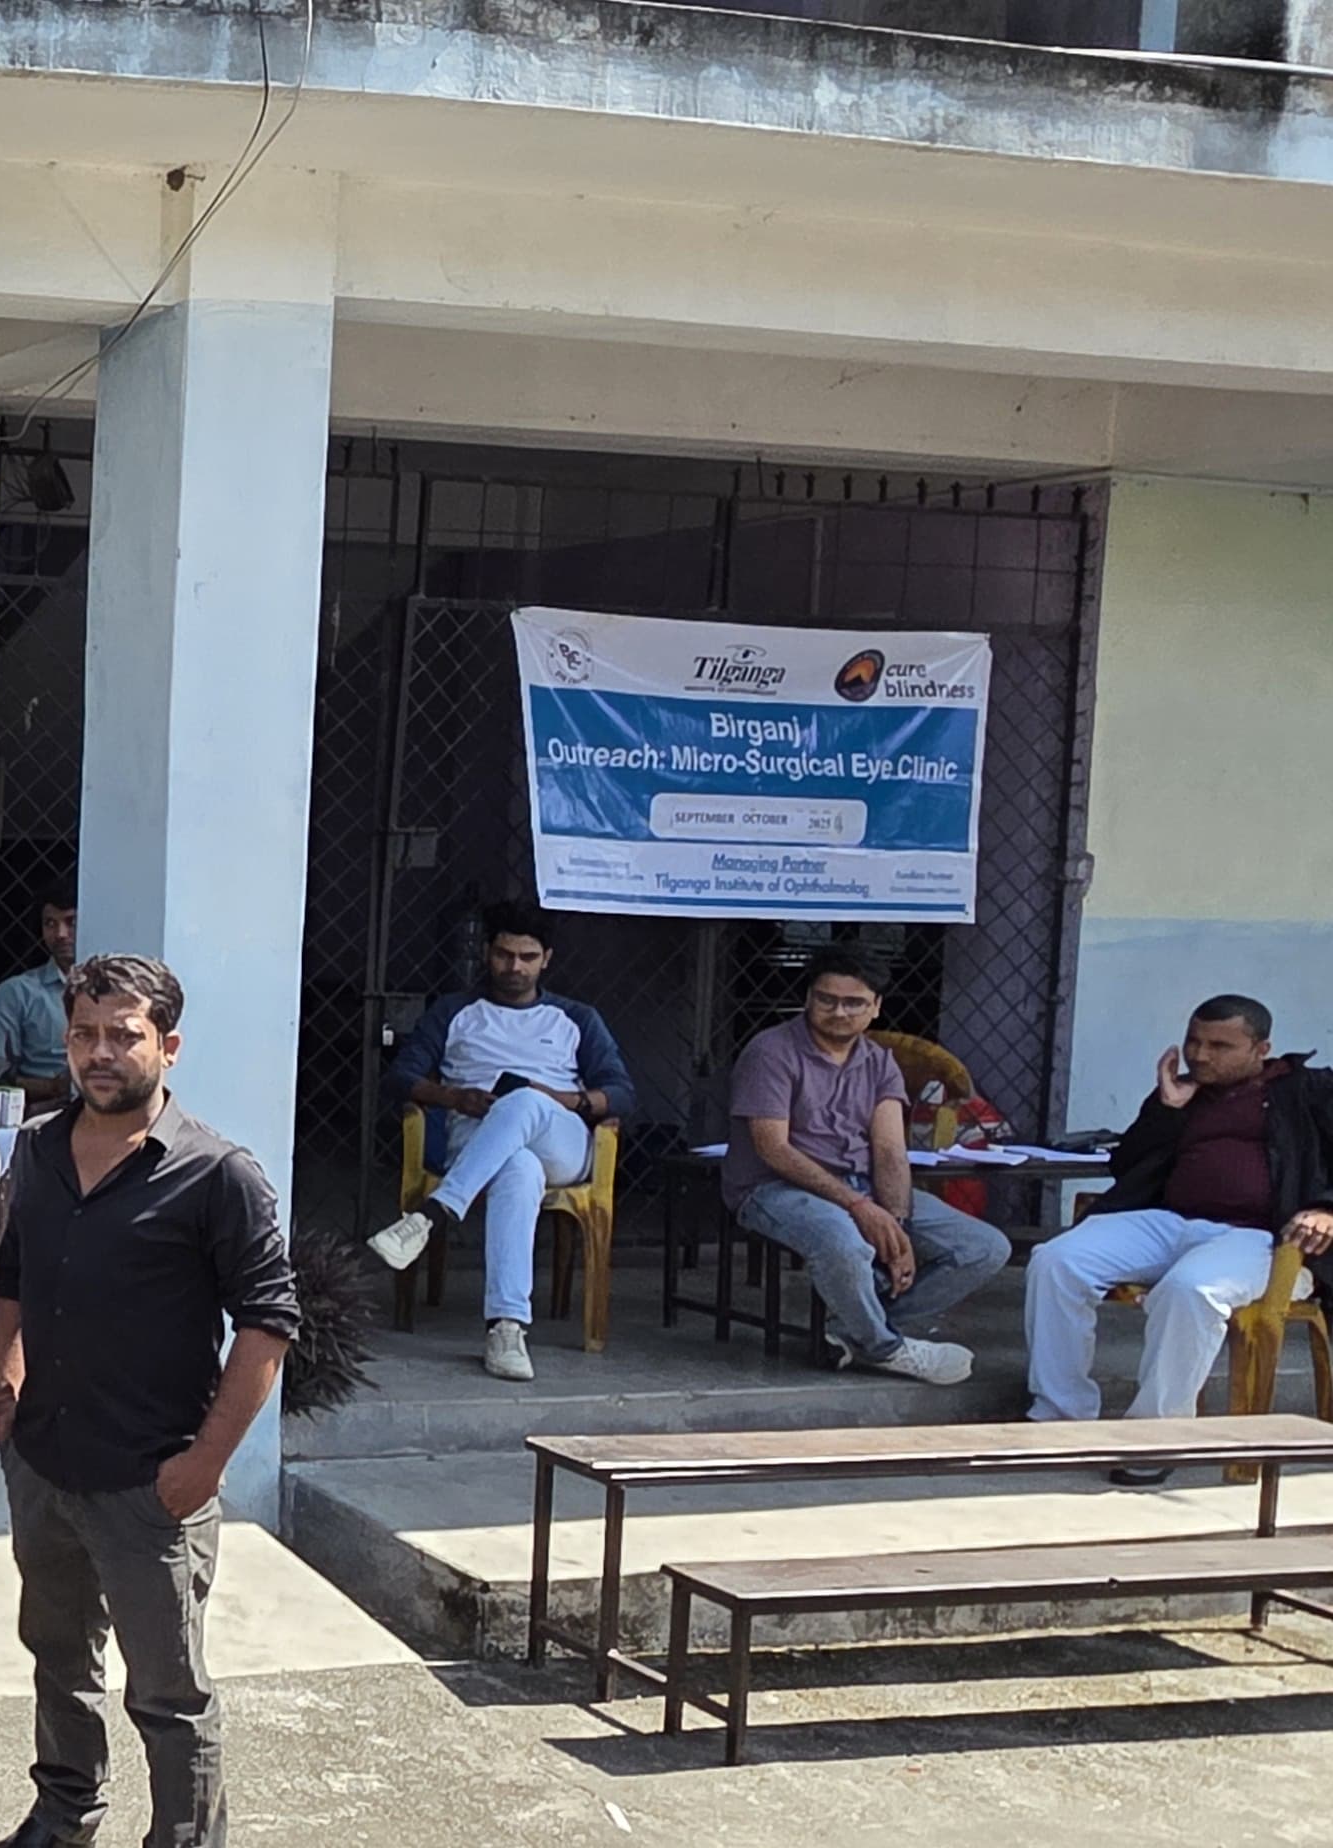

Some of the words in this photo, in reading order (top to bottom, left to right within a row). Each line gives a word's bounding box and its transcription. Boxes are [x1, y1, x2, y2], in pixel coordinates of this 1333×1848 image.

[694, 656, 786, 689] Tilganga
[885, 663, 927, 678] cure
[885, 680, 975, 699] blindness
[710, 711, 801, 749] Birganj
[548, 738, 667, 770] Outreach:
[671, 745, 844, 781] Micro-Surgical
[851, 753, 894, 784] Eye
[897, 755, 958, 781] Clinic
[674, 812, 735, 824] SEPTEMBER
[742, 813, 788, 825] OCTOBER
[712, 853, 779, 874] Managing
[780, 856, 827, 874] Partner
[655, 873, 711, 893] Tilganga
[714, 876, 764, 892] Institute
[767, 876, 781, 892] of
